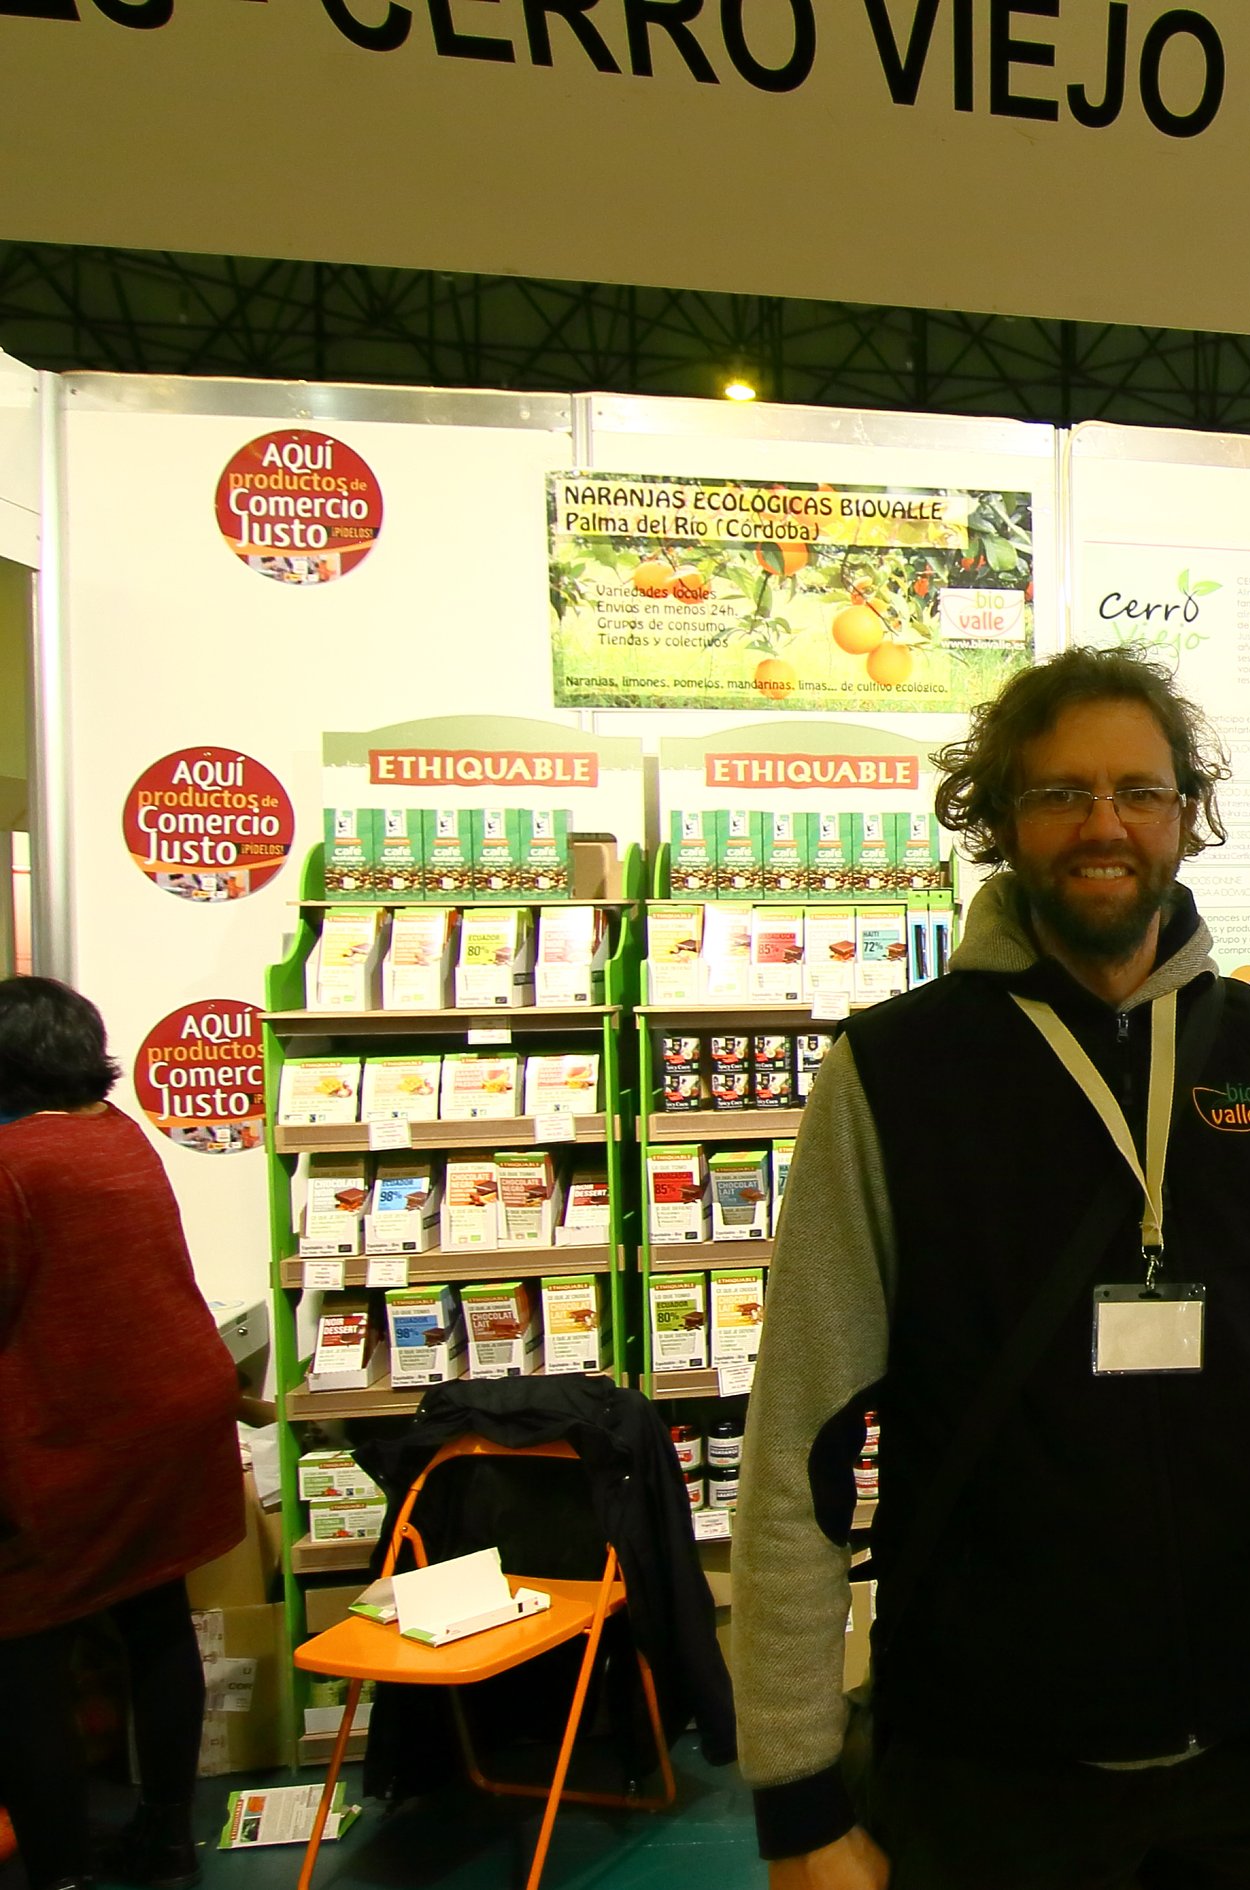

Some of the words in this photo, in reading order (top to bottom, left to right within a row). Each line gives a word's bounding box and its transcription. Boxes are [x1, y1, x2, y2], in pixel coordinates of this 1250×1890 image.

[863, 0, 1224, 138] VIEJO
[262, 440, 334, 473] AQUÍ
[229, 470, 348, 492] productos
[350, 479, 367, 490] de
[229, 488, 368, 519] Comercio
[565, 486, 685, 509] NARANJAS
[694, 489, 832, 515] ECOLÓGICAS
[841, 499, 942, 520] BIOVALLE
[236, 514, 328, 547] Justo
[566, 513, 628, 531] Palma
[637, 515, 666, 534] del
[675, 516, 707, 536] Río
[717, 519, 819, 540] (Córdoba)
[596, 585, 668, 599] Variedades
[673, 586, 716, 599] locales
[976, 591, 1004, 609] bio
[645, 605, 659, 614] en
[664, 605, 705, 615] menos
[598, 617, 644, 630] Grupos
[650, 619, 663, 630] de
[668, 621, 725, 632] consumo
[960, 612, 1004, 631] valle
[599, 634, 649, 646] Tiendas
[666, 634, 728, 648] colectivos
[941, 639, 1025, 650] www.biovalle.es
[841, 682, 853, 691] de
[857, 682, 892, 692] cultivo
[172, 756, 245, 790] AQUÍ
[378, 756, 590, 781] ETHIQUABLE
[714, 759, 911, 784] ETHIQUABLE
[138, 786, 258, 809] productos
[262, 795, 278, 807] de
[138, 806, 280, 836] Comercio
[144, 831, 237, 865] Justo
[864, 942, 883, 952] 72%
[181, 1007, 253, 1043] AQUÍ
[148, 1040, 264, 1062] productos
[149, 1062, 262, 1088] Comerc
[158, 1087, 250, 1120] Justo
[380, 1191, 402, 1202] 98%
[472, 1312, 516, 1320] CHOCOLAT
[657, 1312, 679, 1322] 80%
[324, 1326, 358, 1334] DESSERT
